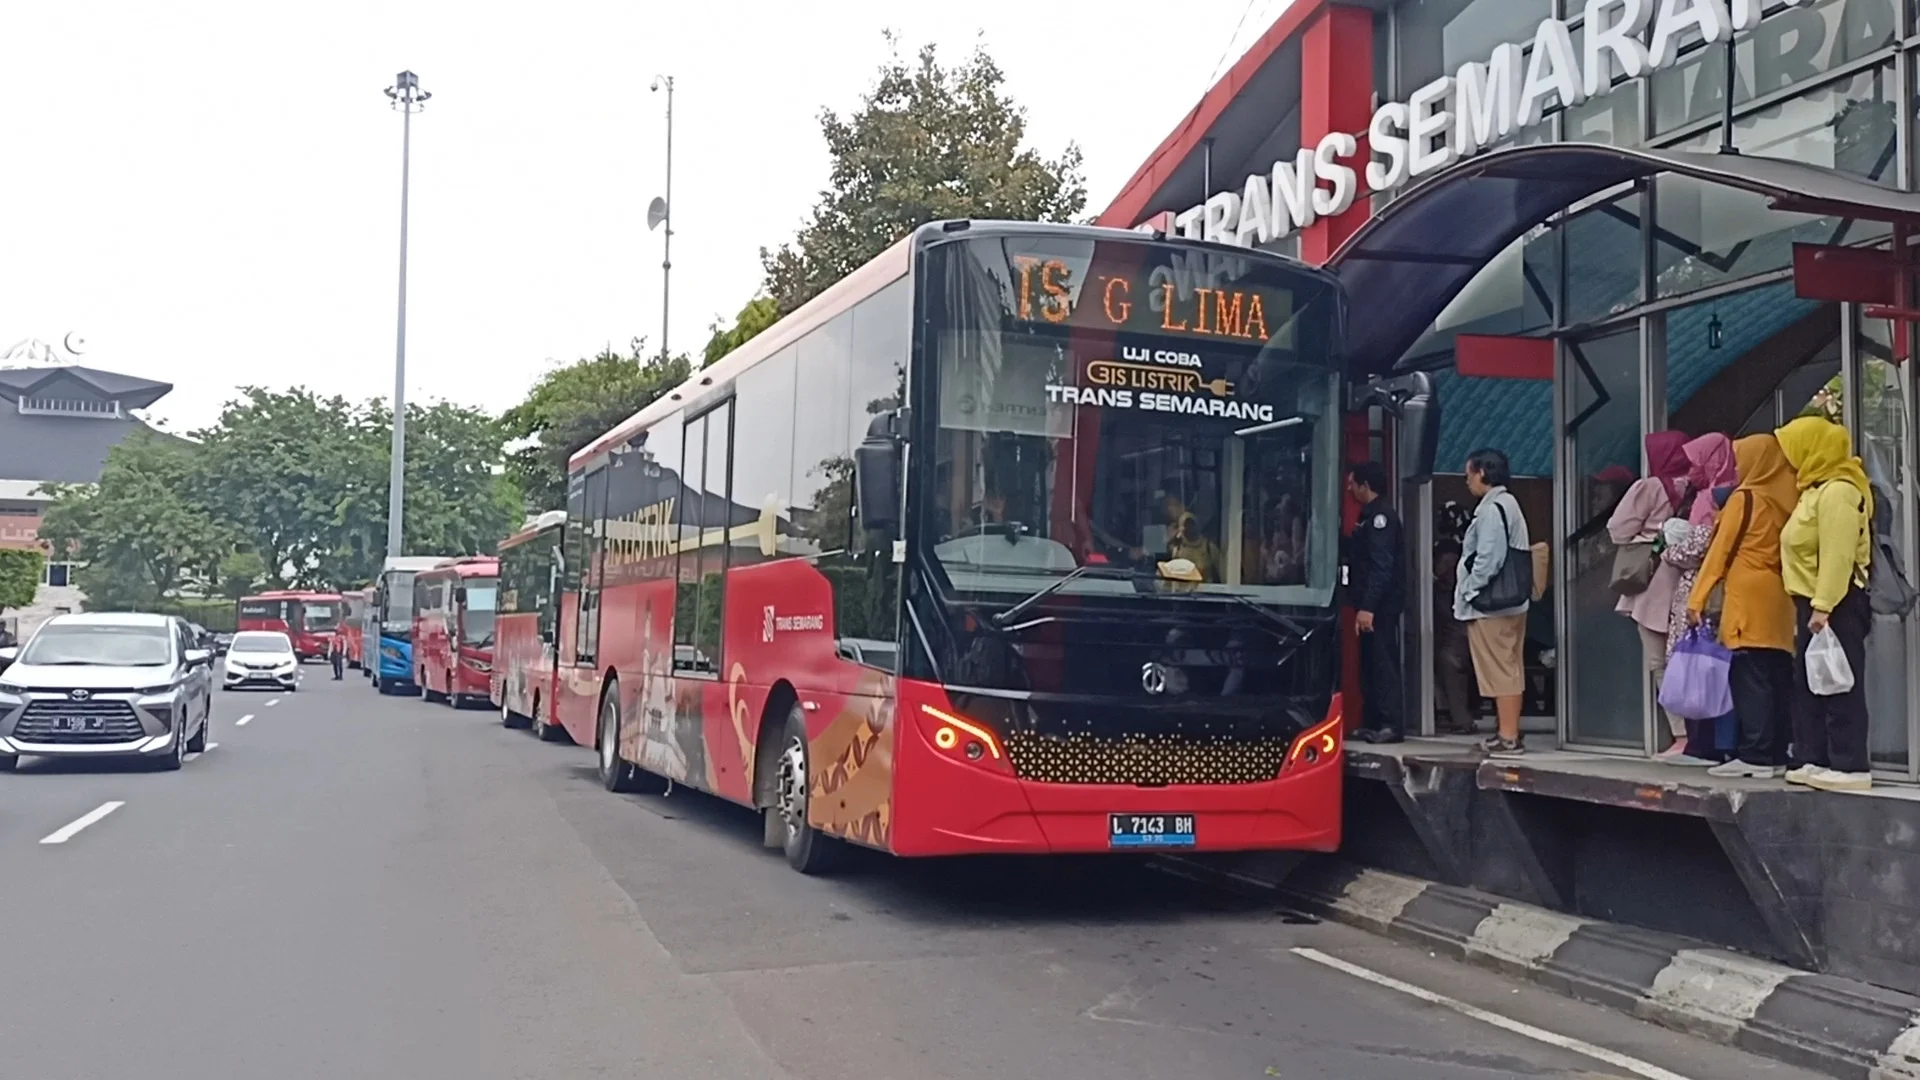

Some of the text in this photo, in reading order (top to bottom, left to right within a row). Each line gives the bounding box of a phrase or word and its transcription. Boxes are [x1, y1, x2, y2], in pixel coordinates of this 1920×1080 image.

[1176, 132, 1357, 248] TRANS
[1161, 284, 1269, 340] LIMA
[1123, 347, 1202, 368] UJI COBA
[1131, 369, 1195, 393] LISTRIK
[1045, 385, 1133, 408] TRANS
[1139, 391, 1273, 422] SEMARANG
[1113, 816, 1192, 834] L 7143 BH
